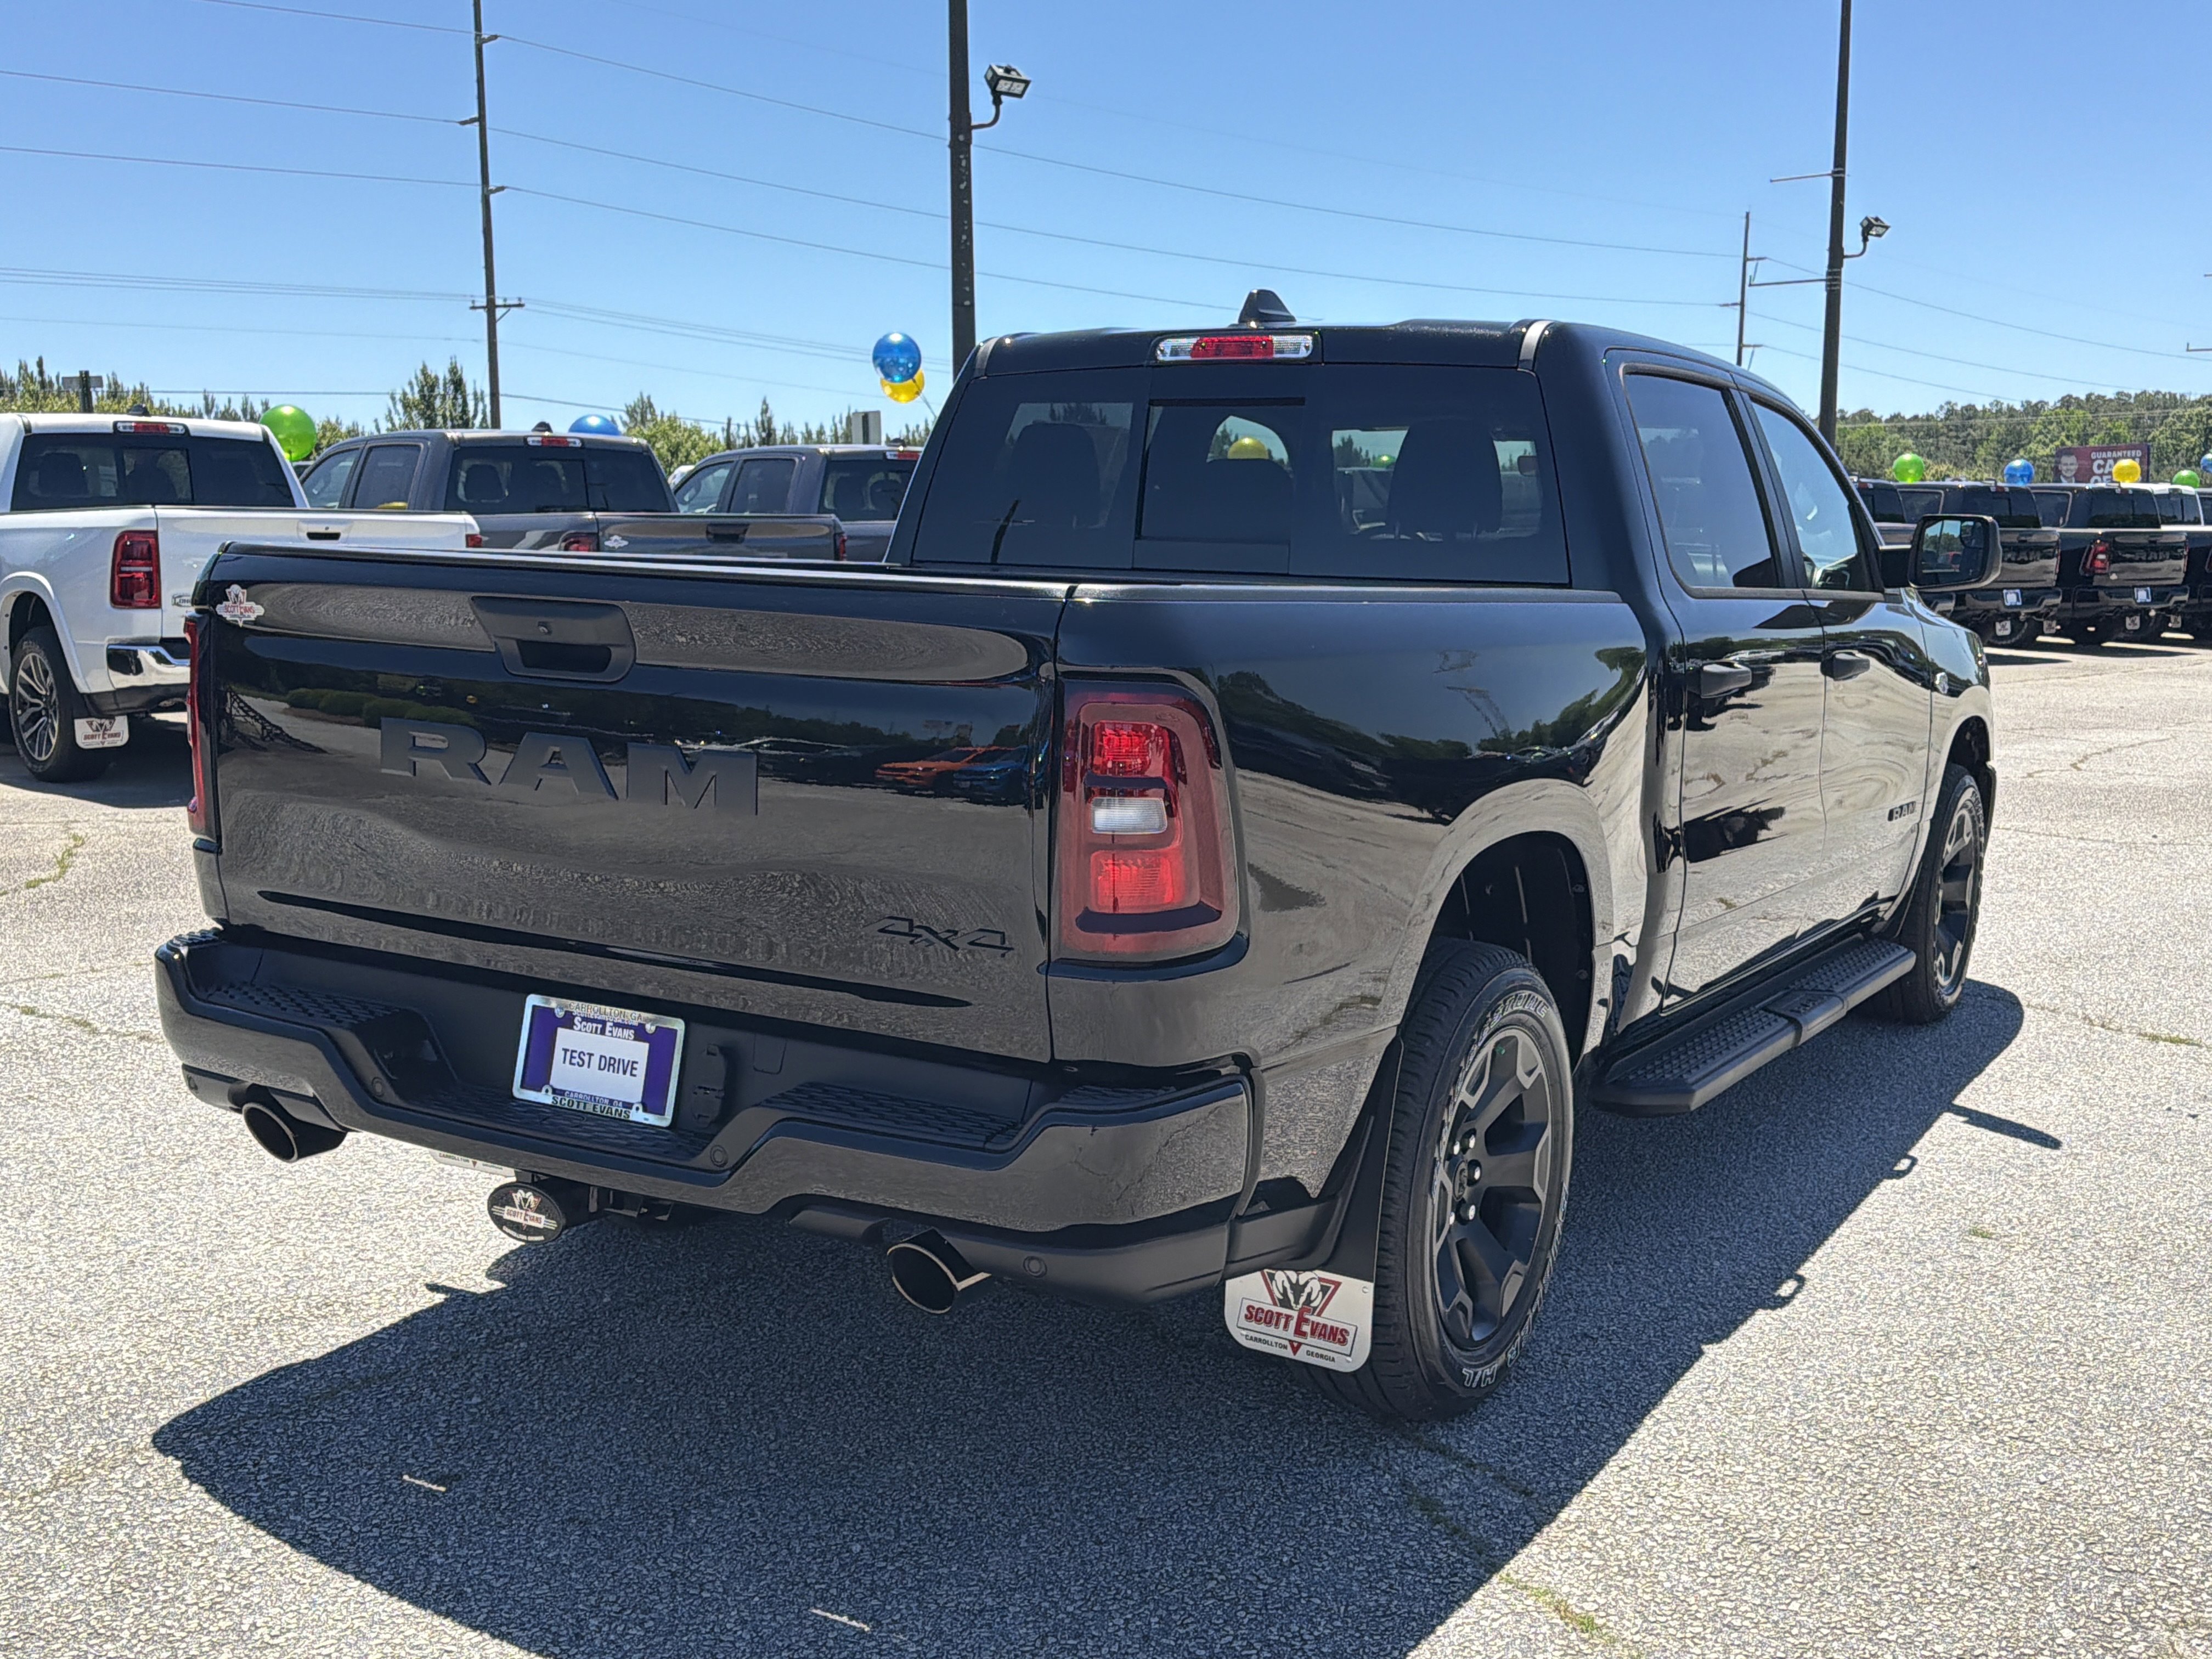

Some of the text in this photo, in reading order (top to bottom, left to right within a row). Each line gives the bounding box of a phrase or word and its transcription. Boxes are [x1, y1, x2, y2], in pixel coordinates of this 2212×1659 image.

[2091, 450, 2142, 459] GUARANTEED
[380, 716, 759, 816] RAM
[1892, 801, 1916, 822] RAM
[630, 1012, 642, 1021] GA
[561, 1047, 639, 1077] TEST DRIVE
[551, 1096, 631, 1119] SCOTT EVANS
[506, 1209, 543, 1224] SCOTT EVANS
[1244, 1304, 1350, 1346] SCOTT EVANS
[1245, 1334, 1336, 1363] CARROLLTON GEORGIA
